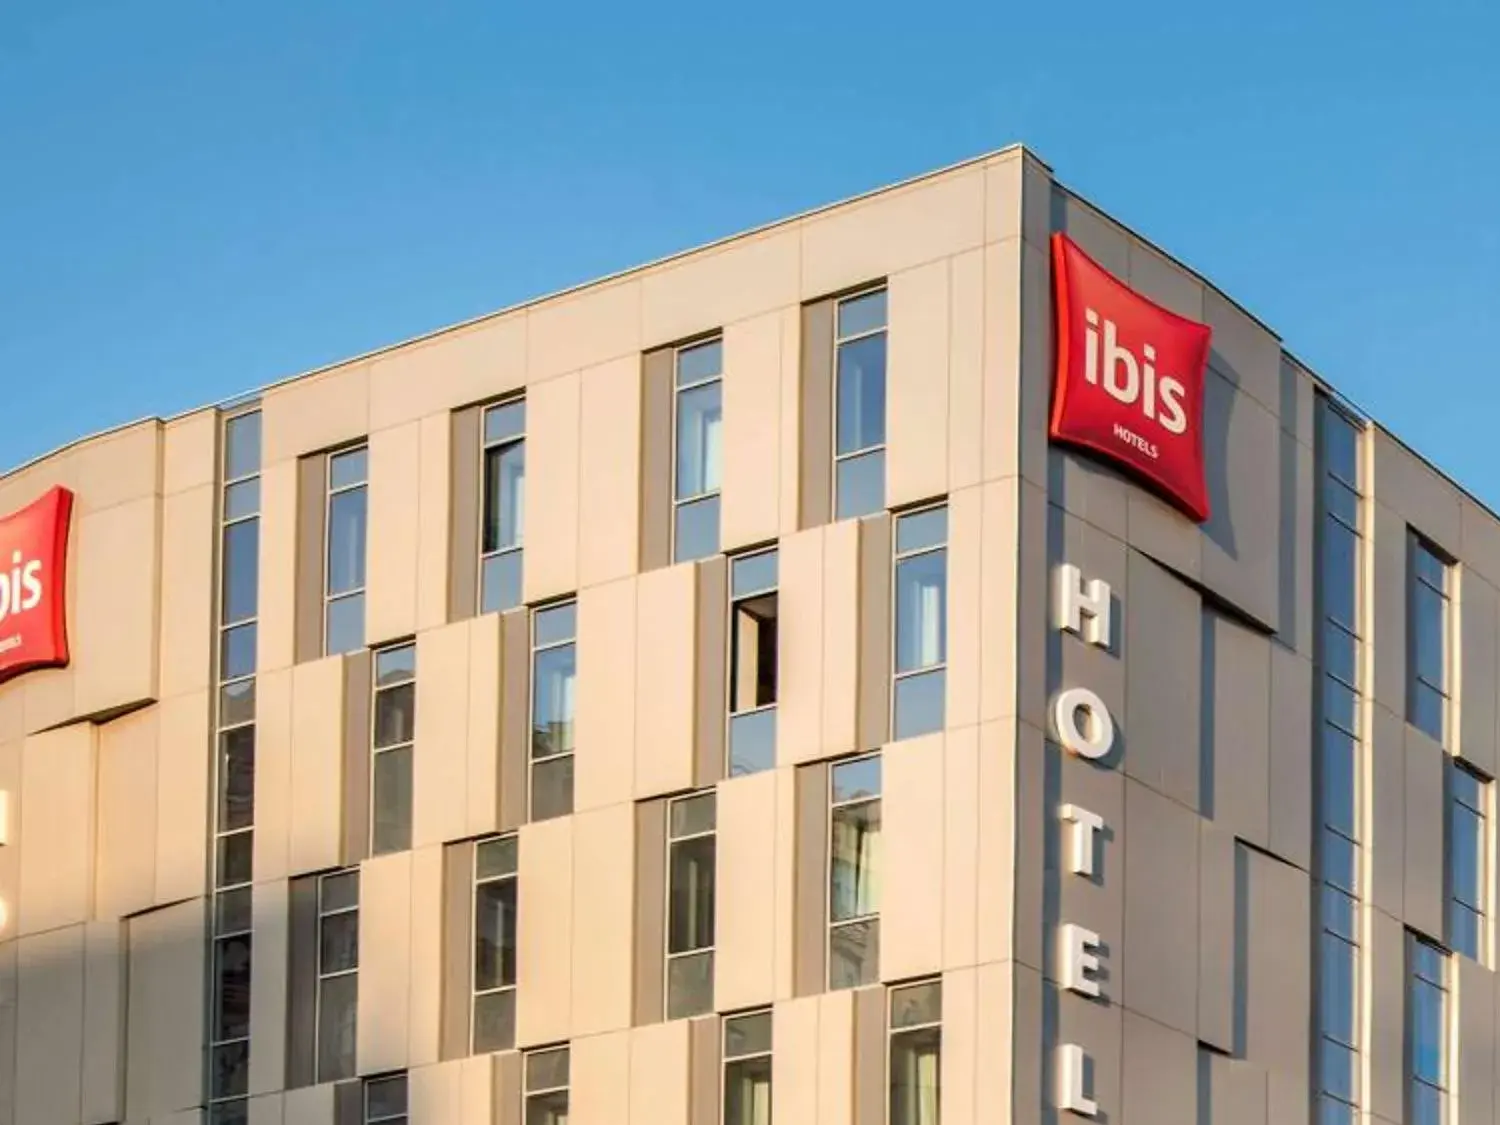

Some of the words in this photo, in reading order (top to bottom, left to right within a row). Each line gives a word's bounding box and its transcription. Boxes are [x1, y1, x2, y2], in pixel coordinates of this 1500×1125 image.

[1085, 307, 1187, 434] ibis
[1113, 423, 1160, 459] HOTELS
[0, 549, 42, 622] is
[1055, 563, 1114, 1118] HOTEL
